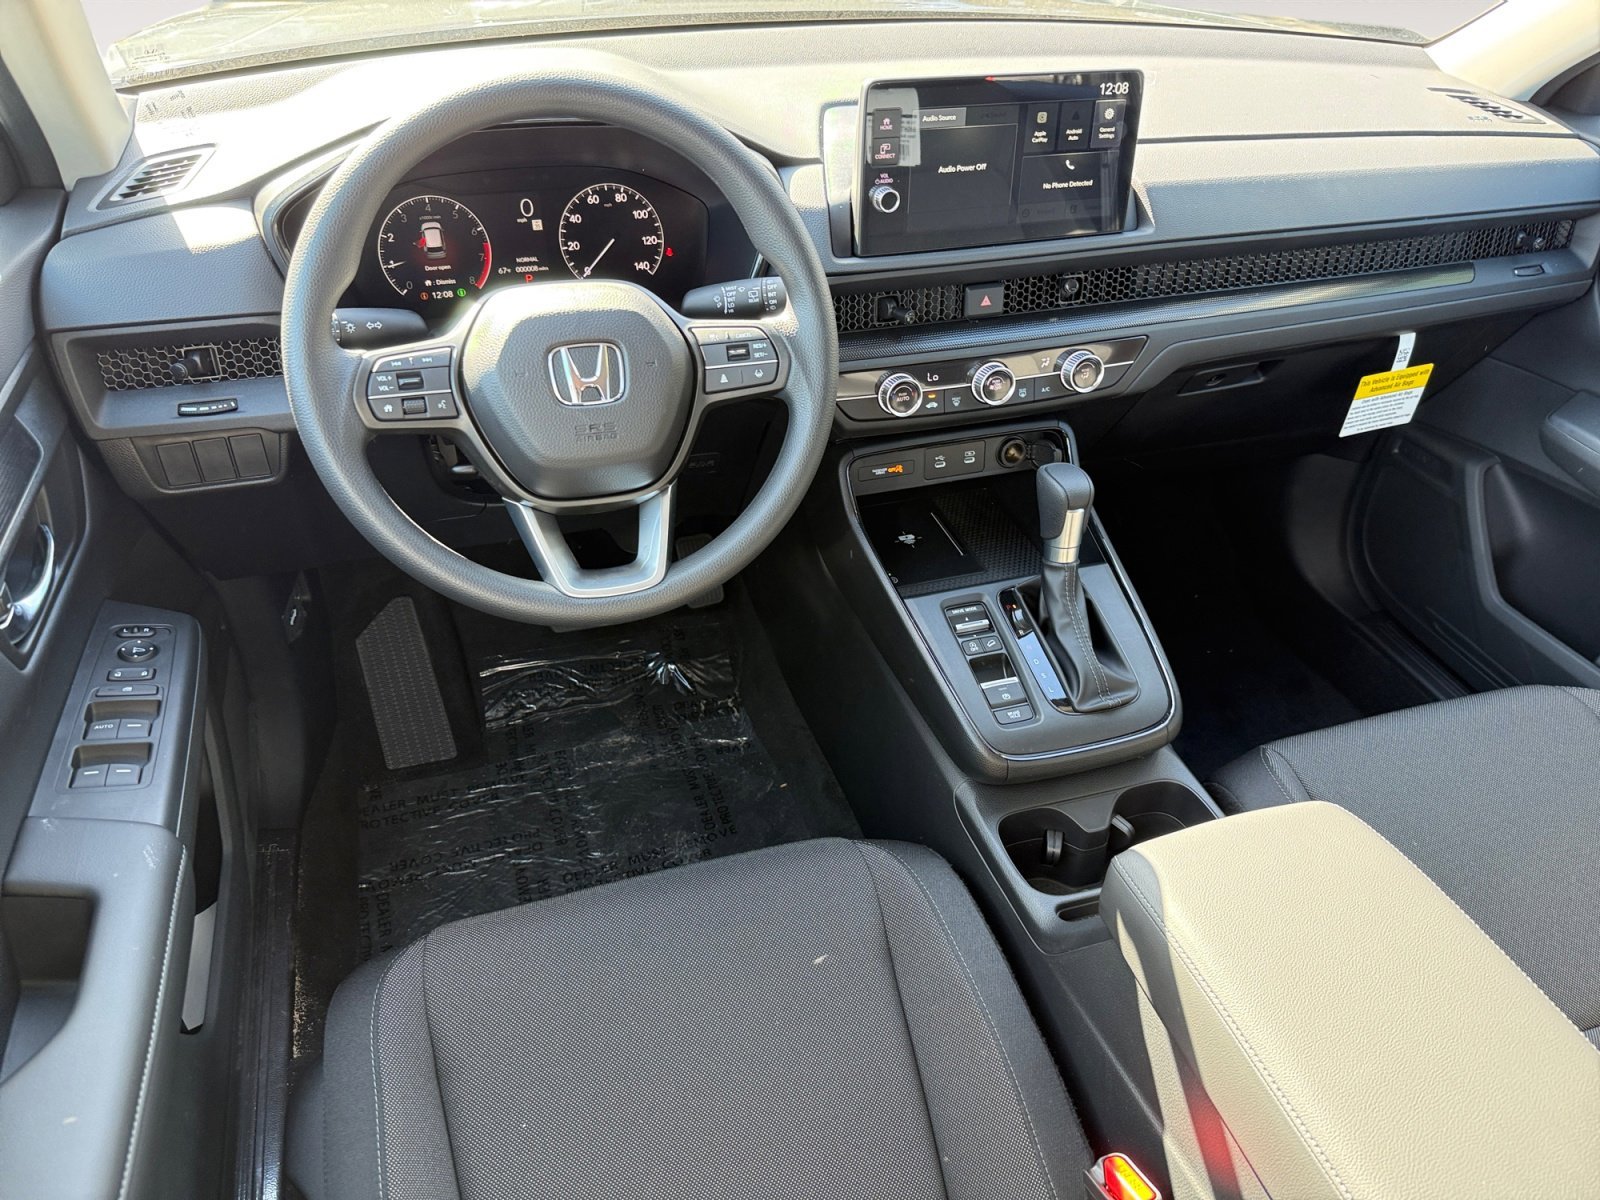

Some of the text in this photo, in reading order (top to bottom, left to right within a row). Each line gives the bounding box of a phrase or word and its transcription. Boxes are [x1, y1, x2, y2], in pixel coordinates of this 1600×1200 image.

[1100, 82, 1129, 95] 12:08
[938, 163, 988, 173] Audio Power Off
[1051, 181, 1068, 189] Phone
[1068, 179, 1093, 188] Detected
[587, 195, 600, 205] 60
[615, 193, 627, 203] 80
[425, 204, 431, 212] 4
[520, 198, 534, 217] 0
[400, 214, 408, 223] 3
[452, 210, 459, 219] 5
[569, 214, 582, 223] 40
[632, 210, 649, 220] 100
[471, 228, 478, 236] 6
[387, 233, 395, 242] 2
[641, 236, 658, 246] 120
[568, 242, 580, 251] 20
[478, 253, 484, 261] 7
[515, 265, 539, 273] 000008
[634, 262, 650, 271] 140
[436, 278, 456, 286] Dismiss
[469, 276, 476, 285] 8
[525, 274, 533, 283] P
[405, 281, 413, 290] 0
[432, 291, 454, 299] 12:08
[927, 373, 939, 382] Lo
